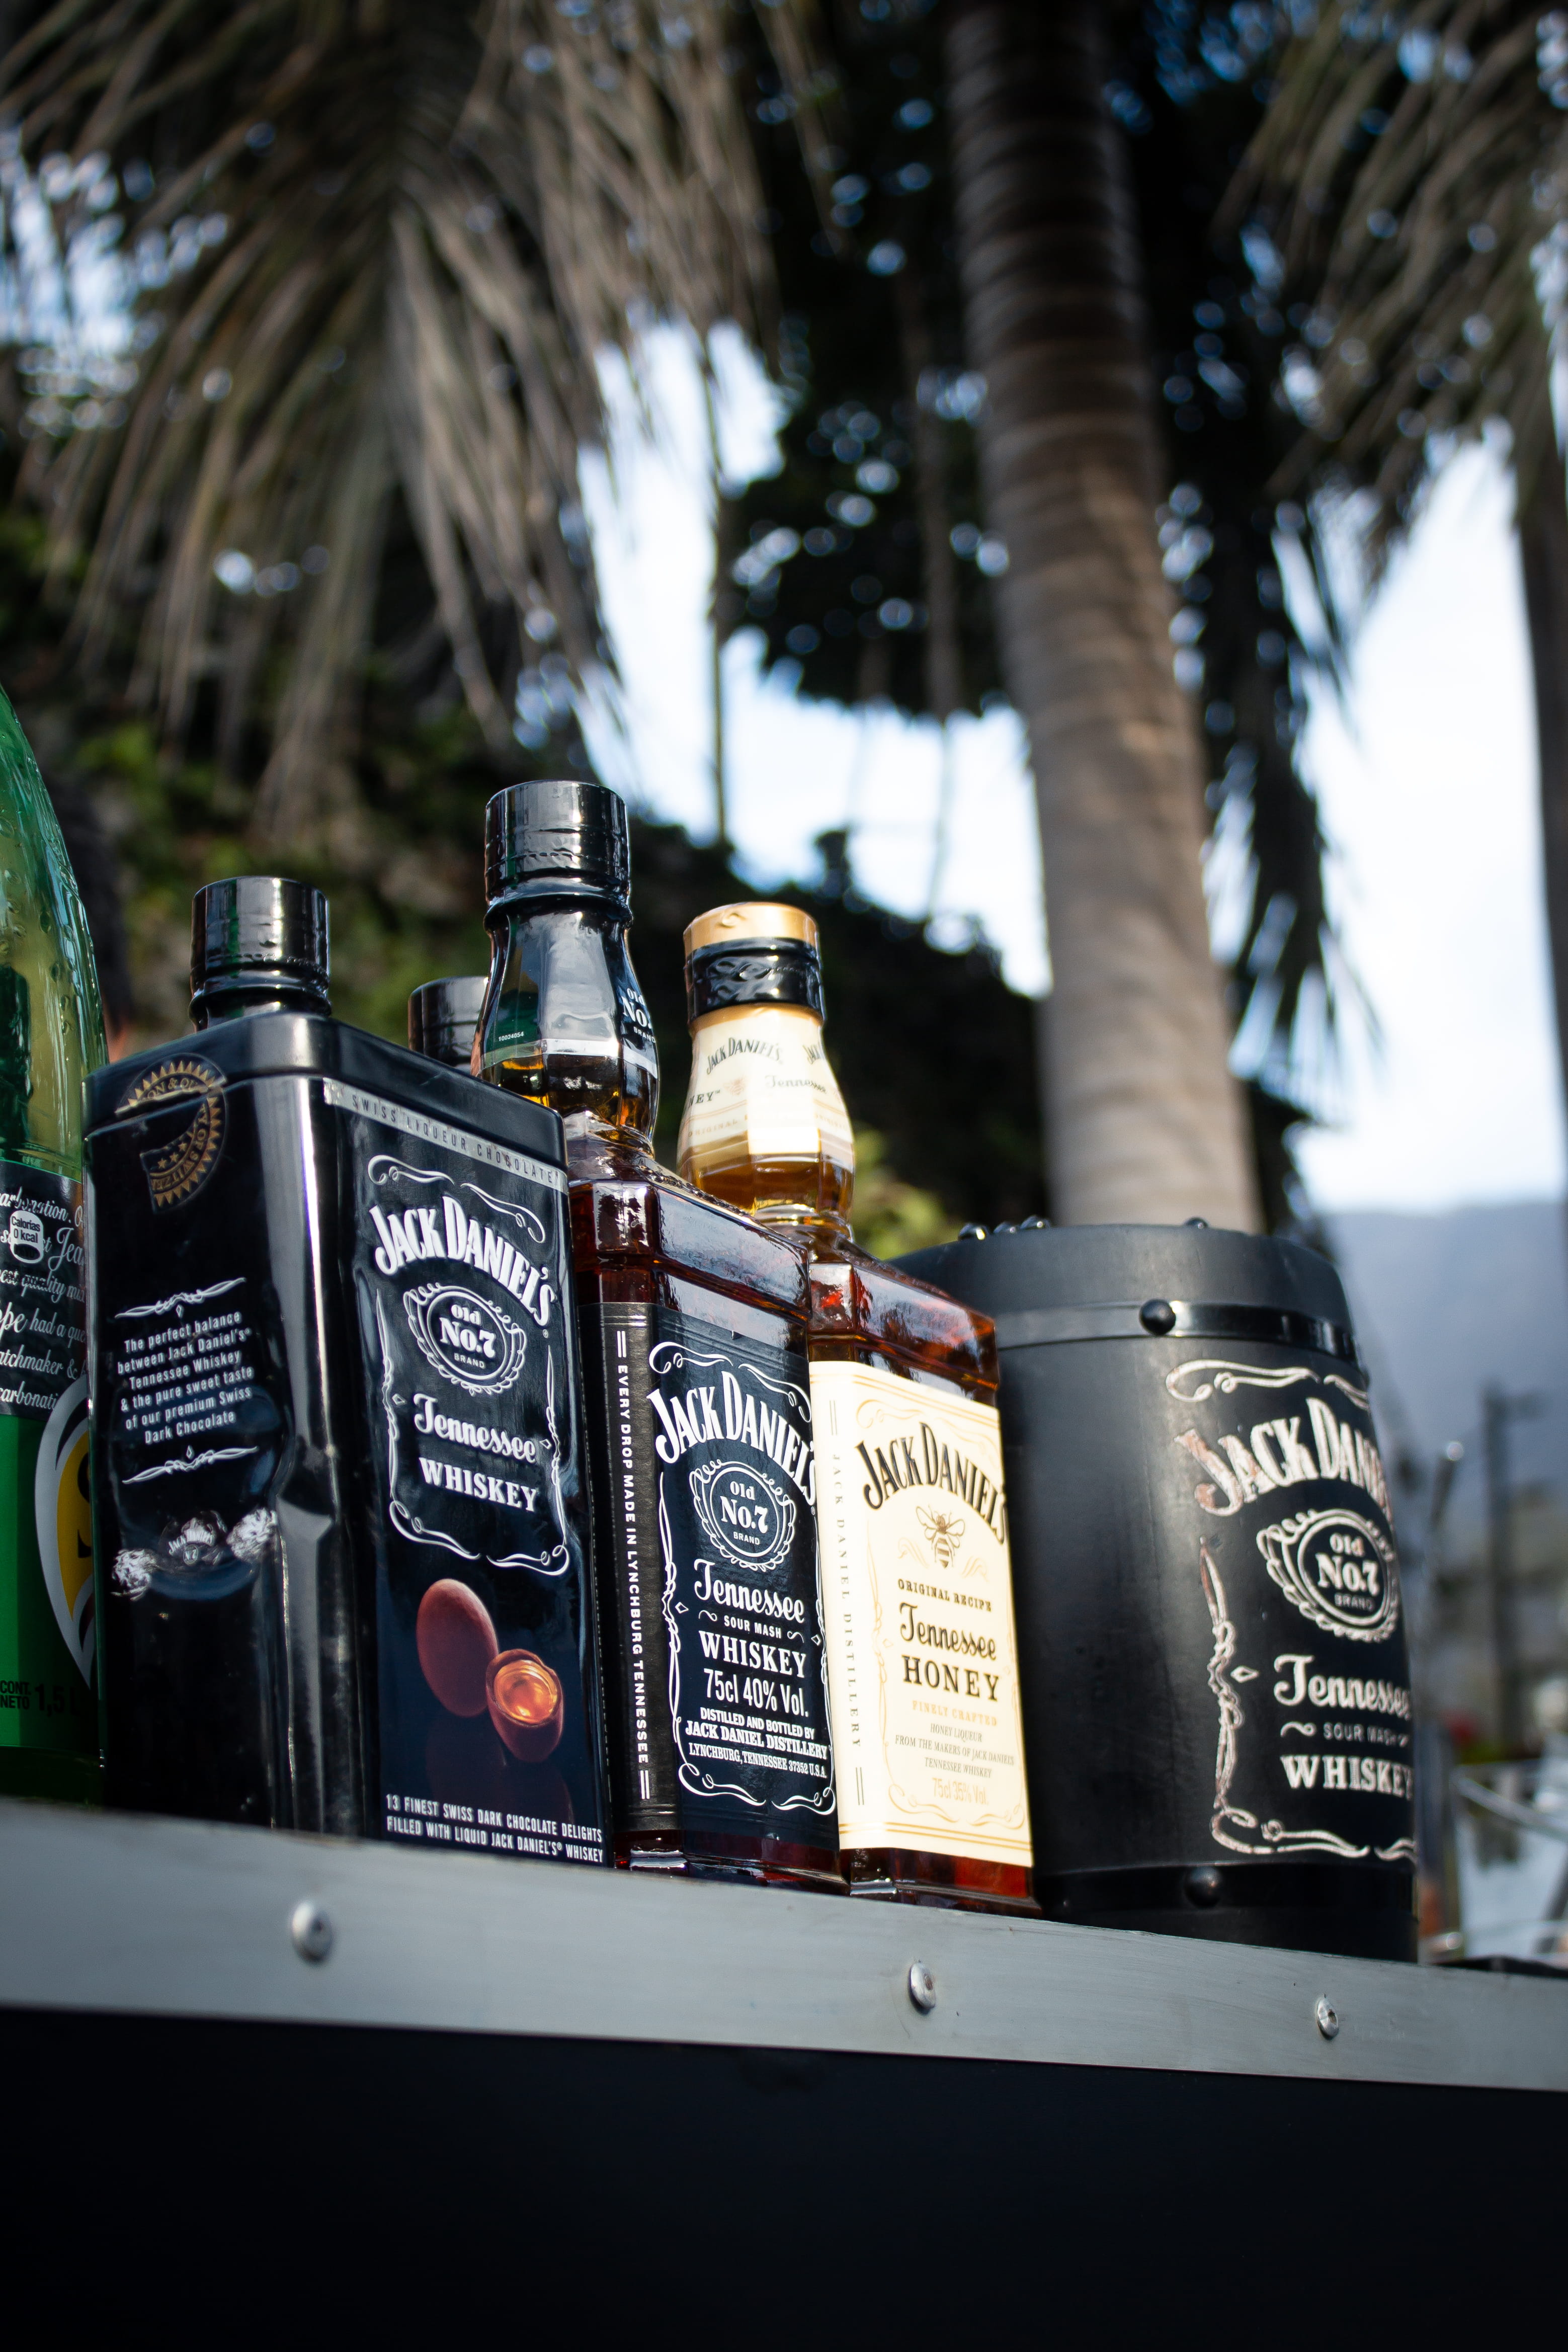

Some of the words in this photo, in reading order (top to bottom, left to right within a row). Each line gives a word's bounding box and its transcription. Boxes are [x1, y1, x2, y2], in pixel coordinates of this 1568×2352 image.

[499, 1031, 524, 1041] 10024054
[706, 1045, 726, 1075] JACK
[353, 1095, 396, 1122] SWISS
[407, 1116, 466, 1150] LIQUEUR
[11, 1216, 40, 1232] Calorias
[14, 1229, 19, 1238] 0
[21, 1230, 38, 1243] kcal
[369, 1204, 446, 1275] JACK
[442, 1195, 556, 1326] DANIEL'S
[29, 1308, 55, 1334] had
[56, 1324, 66, 1337] a
[124, 1339, 145, 1353] The
[148, 1324, 192, 1350] perfect
[195, 1312, 242, 1333] balance
[451, 1304, 481, 1326] Old
[439, 1317, 496, 1358] No.7
[67, 1358, 78, 1380] &
[117, 1352, 165, 1375] between
[168, 1342, 195, 1360] Jack
[129, 1364, 190, 1391] Tennessee
[193, 1350, 241, 1373] Whiskey
[454, 1353, 486, 1369] BRAND
[121, 1398, 129, 1413] &
[132, 1395, 151, 1409] the
[155, 1386, 183, 1405] pure
[186, 1374, 221, 1395] sweet
[223, 1366, 254, 1385] taste
[126, 1415, 138, 1430] of
[141, 1411, 161, 1426] our
[165, 1397, 216, 1422] premium
[219, 1387, 252, 1406] Swiss
[618, 1365, 631, 1420] EVERY
[145, 1426, 173, 1444] Dark
[176, 1411, 236, 1436] Chocolate
[413, 1393, 536, 1463] Tennessee
[646, 1386, 725, 1464] JACK
[620, 1424, 633, 1470] DROP
[1174, 1416, 1320, 1516] JACK
[419, 1457, 538, 1512] WHISKEY
[730, 1481, 754, 1501] Old
[832, 1454, 843, 1504] JACK
[855, 1436, 924, 1511] JACK
[623, 1475, 636, 1523] MADE
[720, 1496, 768, 1534] No.7
[626, 1527, 637, 1545] IN
[733, 1531, 760, 1546] BRAND
[836, 1519, 851, 1599] DANIEL
[1315, 1553, 1380, 1596] No.7
[627, 1551, 643, 1655] LYNCHBURG
[694, 1558, 805, 1624] Tennessee
[898, 1578, 950, 1601] ORIGINAL
[953, 1593, 992, 1612] RECIPE
[1334, 1593, 1374, 1610] BRAND
[724, 1615, 750, 1632] SOUR
[754, 1622, 782, 1639] MASH
[899, 1602, 997, 1661] Tennessee
[699, 1630, 806, 1678] WHISKEY
[704, 1668, 738, 1704] 75cl
[743, 1677, 777, 1711] 40%
[780, 1683, 808, 1717] Vol.
[844, 1613, 861, 1747] DISTILLERY
[901, 1654, 999, 1702] HONEY
[0, 1695, 30, 1709] NETO
[633, 1660, 649, 1763] TENNESSEE
[912, 1700, 949, 1718] FINELY
[952, 1708, 997, 1726] CRAFTED
[685, 1720, 719, 1739] JACK
[720, 1725, 765, 1747] DANIEL
[766, 1734, 828, 1760] DISTILLERY
[700, 1707, 745, 1726] DISTILLED
[747, 1716, 764, 1730] AND
[766, 1719, 803, 1738] BOTTLED
[804, 1727, 814, 1740] BY
[930, 1723, 952, 1737] HONEY
[954, 1728, 982, 1742] LIQUEUR
[1323, 1722, 1364, 1742] SOUR
[689, 1742, 742, 1764] LYNCHBURG,
[742, 1750, 787, 1770] TENNESSEE
[788, 1760, 808, 1774] 37352
[809, 1762, 827, 1778] U.S.A.
[895, 1734, 916, 1747] FROM
[918, 1738, 932, 1750] THE
[934, 1741, 961, 1756] MAKERS
[962, 1748, 971, 1757] OF
[971, 1749, 987, 1761] JACK
[925, 1757, 961, 1773] TENNESSEE
[963, 1764, 992, 1778] WHISKEY
[932, 1777, 951, 1799] 75cl
[953, 1780, 972, 1803] 35%
[1280, 1755, 1414, 1801] WHISKEY
[386, 1793, 400, 1811] 13
[404, 1797, 439, 1817] FINEST
[443, 1803, 474, 1823] SWISS
[477, 1809, 503, 1827] DARK
[506, 1813, 557, 1835] CHOCOLATE
[561, 1822, 602, 1843] DELIGHTS
[386, 1815, 422, 1836] FILLED
[426, 1822, 451, 1840] WITH
[455, 1827, 487, 1845] LIQUID
[491, 1832, 514, 1849] JACK
[565, 1843, 603, 1862] WHISKEY
